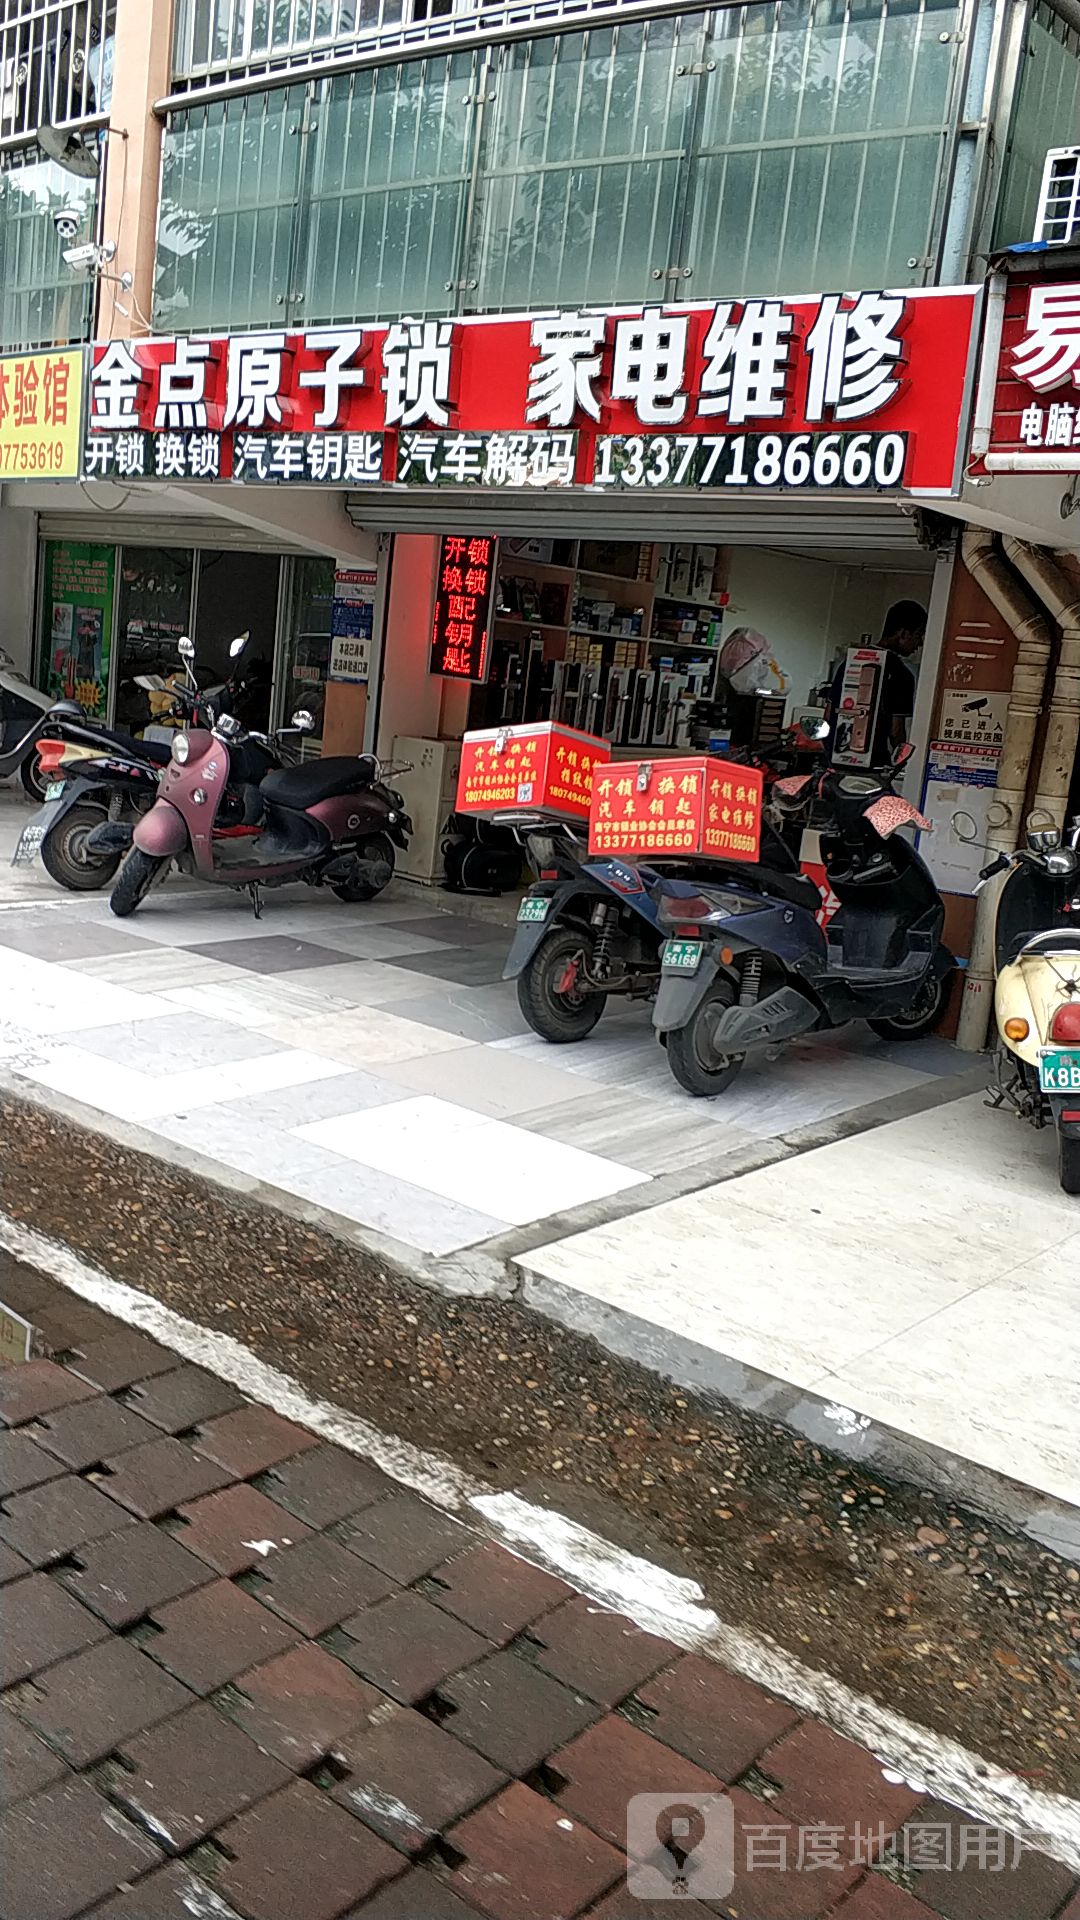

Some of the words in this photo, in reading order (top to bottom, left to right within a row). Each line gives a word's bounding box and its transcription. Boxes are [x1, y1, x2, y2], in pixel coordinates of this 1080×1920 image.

[90, 318, 454, 430] 金点原子锁
[525, 291, 905, 427] 家电维修
[0, 441, 64, 470] 7753619
[85, 432, 145, 476] 开锁
[155, 432, 219, 477] 换锁
[233, 434, 382, 480] 汽车钥匙
[398, 433, 576, 486] 汽车解码
[595, 434, 905, 485] 13377186660
[445, 537, 490, 565] 开锁
[443, 565, 487, 595] 换锁
[443, 595, 476, 673] 配钥匙
[944, 718, 1003, 731] 您已进入
[944, 729, 1003, 742] 视频监控范围
[597, 778, 634, 798] 开锁
[657, 774, 698, 795] 换锁
[709, 778, 732, 800] 开锁
[598, 796, 693, 818] 汽车钥匙
[708, 802, 756, 830] 家电维修
[595, 832, 693, 848] 13377186660
[663, 951, 697, 966] 56168
